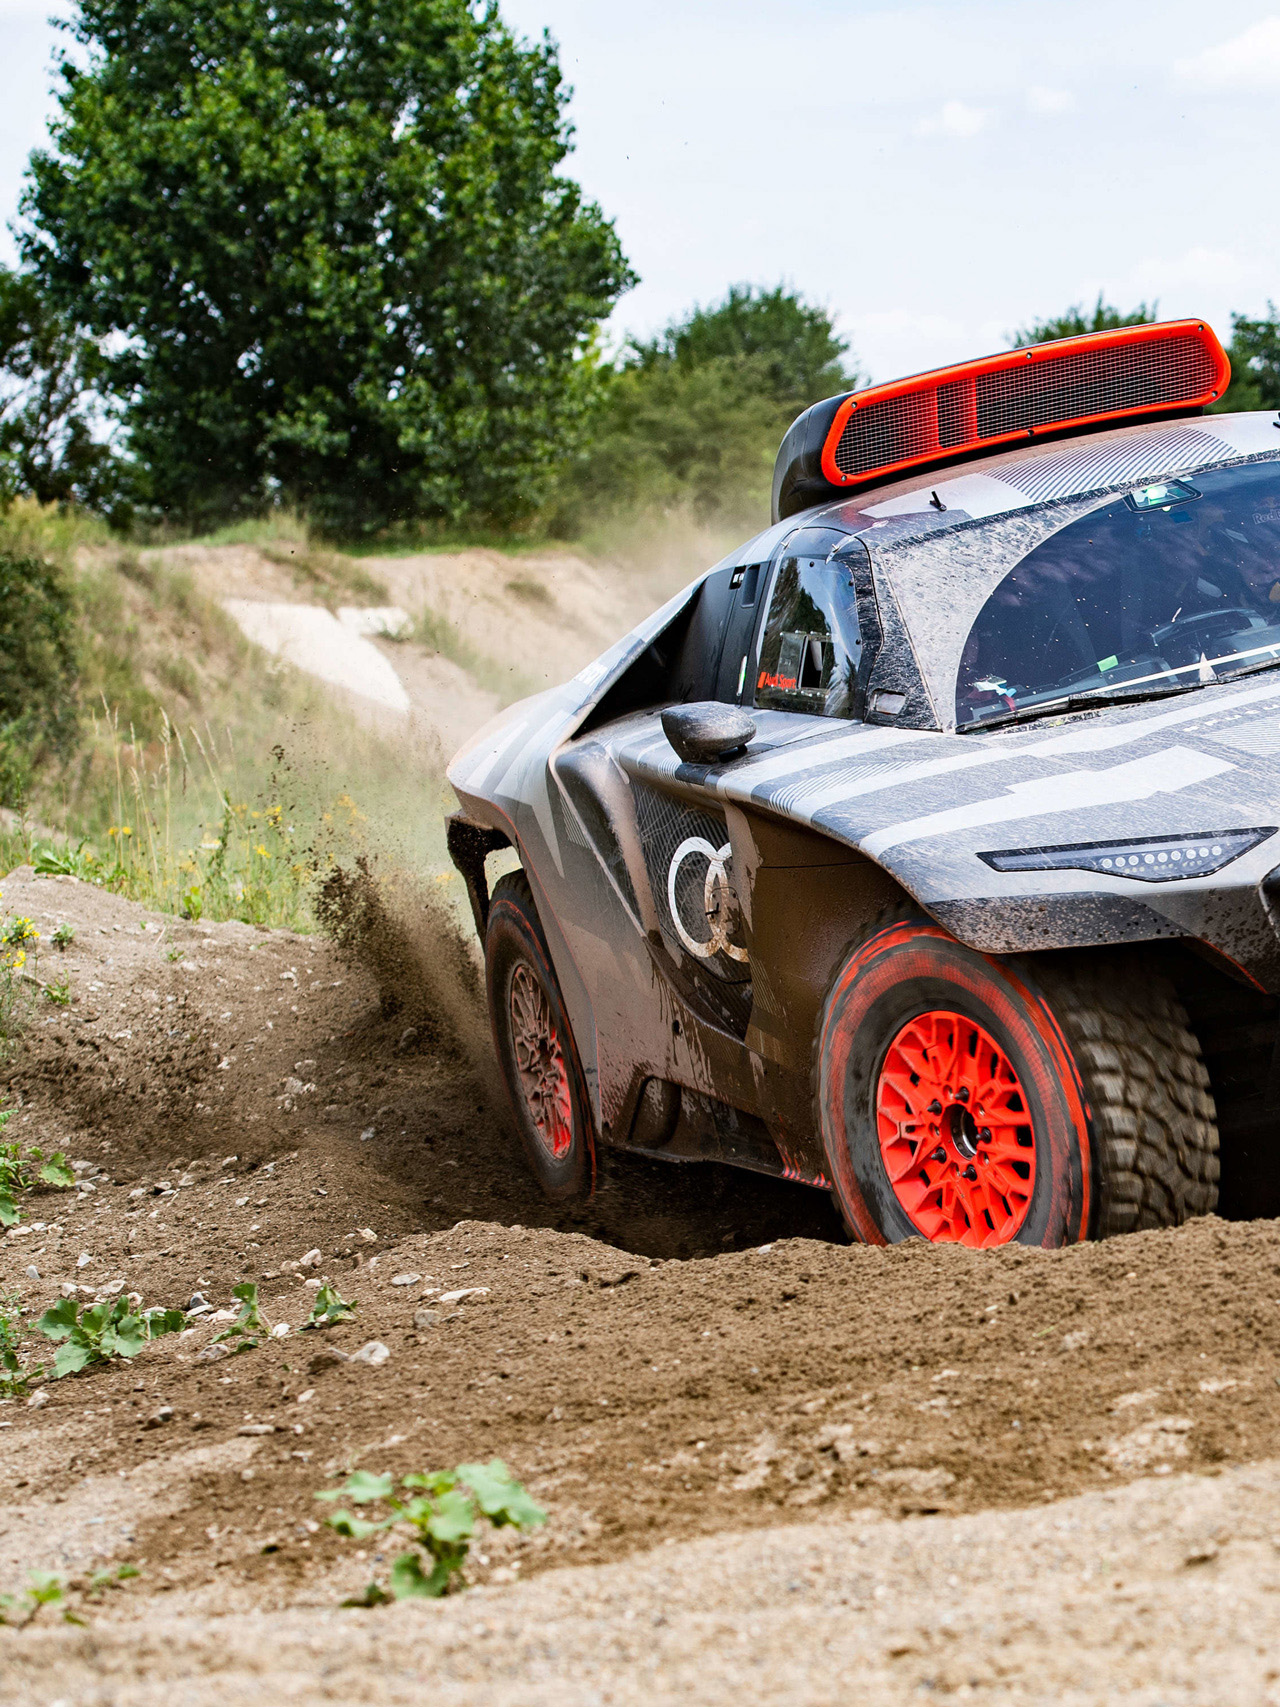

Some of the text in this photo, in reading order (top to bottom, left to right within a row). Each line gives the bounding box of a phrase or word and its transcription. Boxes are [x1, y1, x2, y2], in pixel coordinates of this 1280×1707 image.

[1252, 509, 1276, 525] Red
[765, 672, 797, 691] Audi Sport
